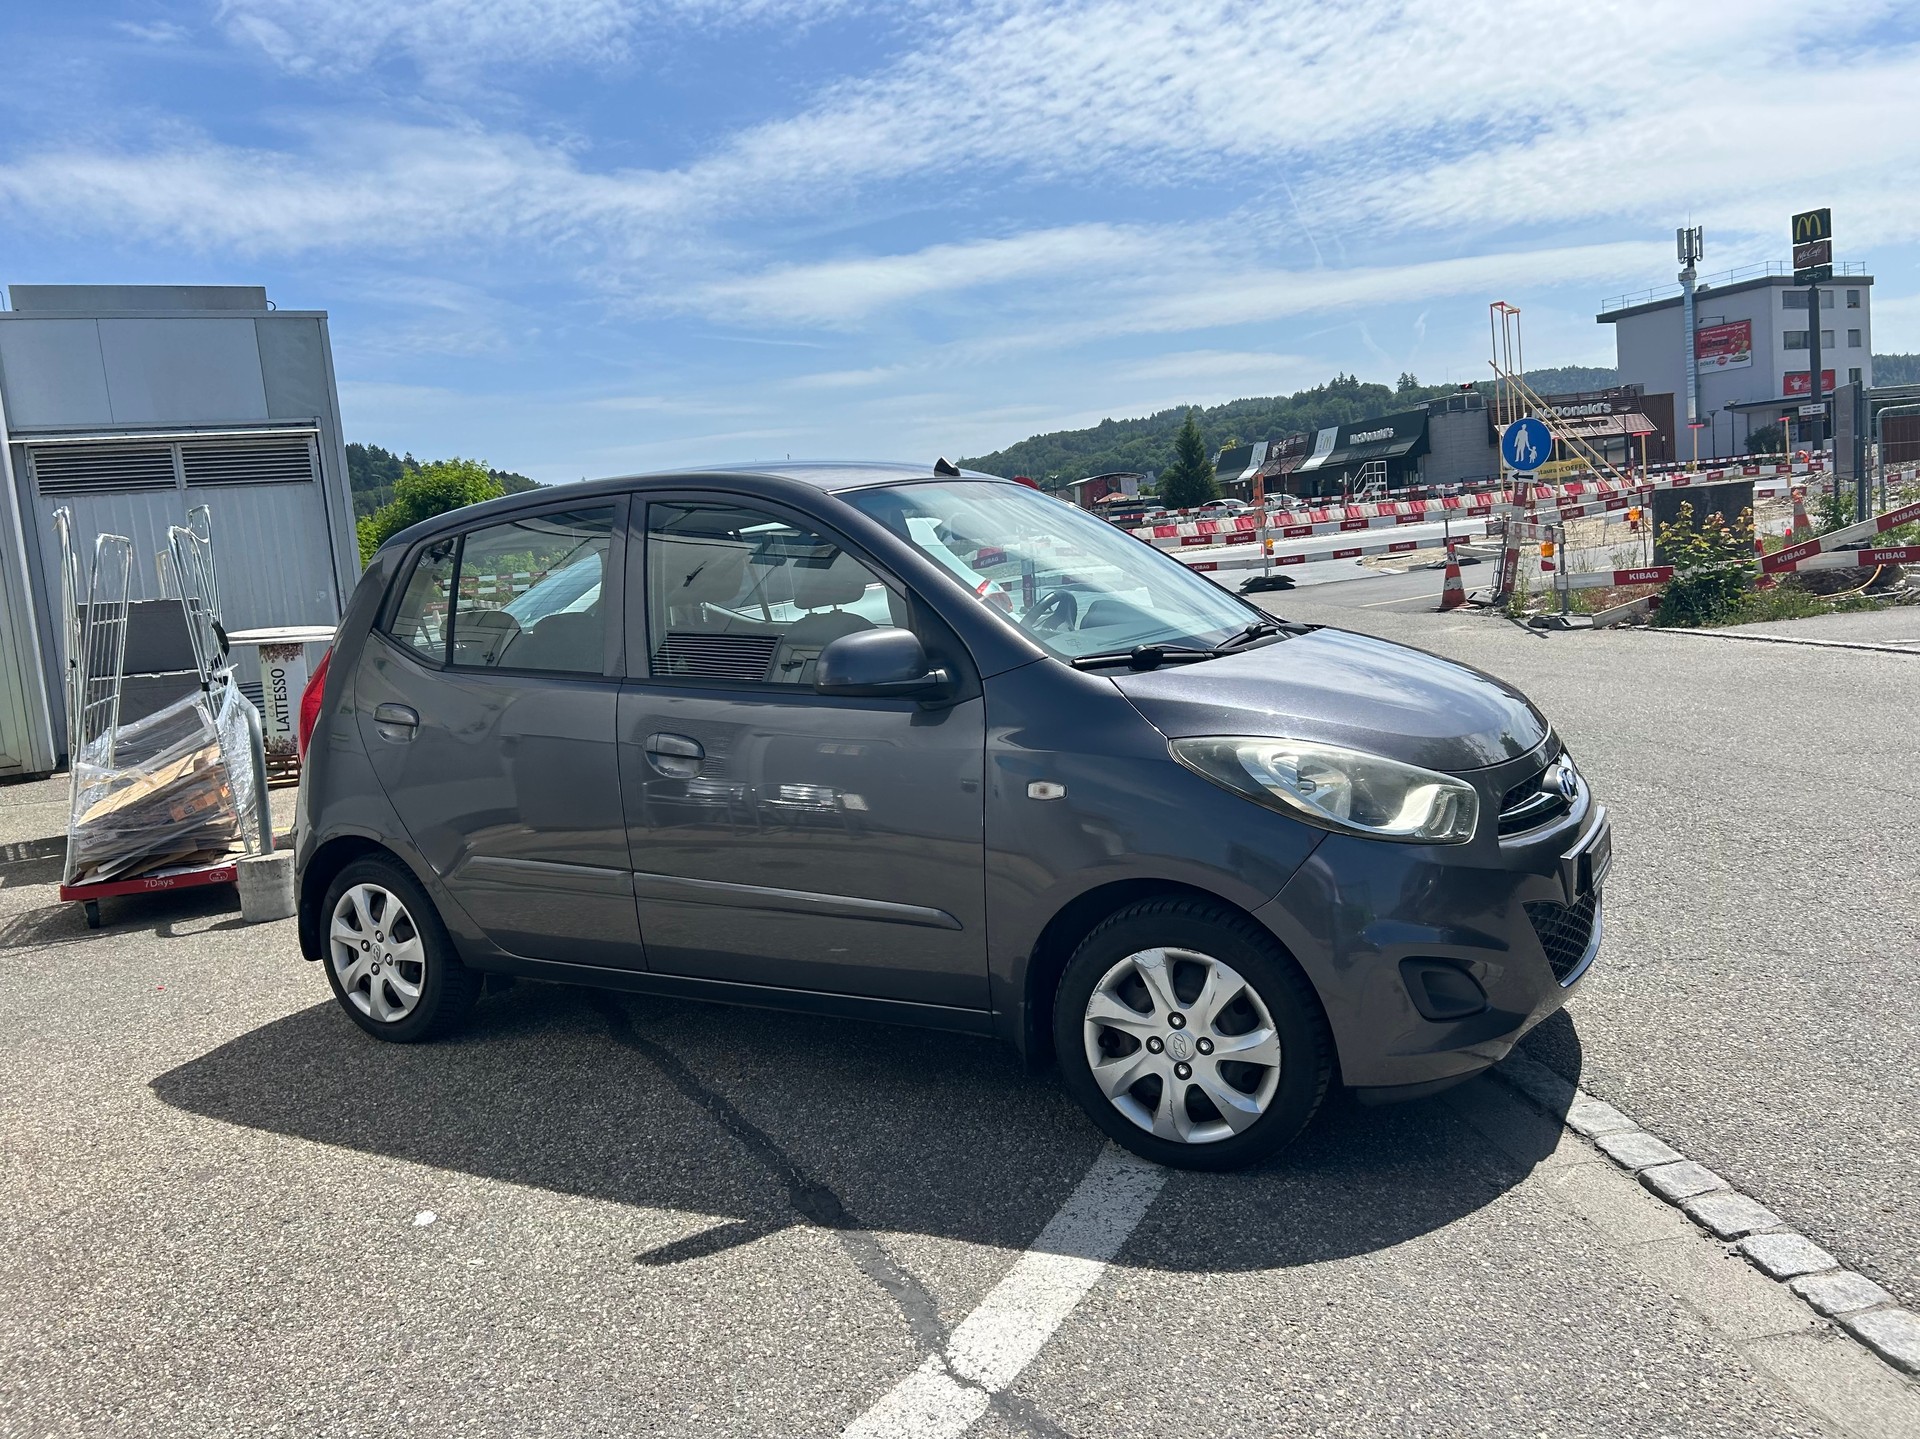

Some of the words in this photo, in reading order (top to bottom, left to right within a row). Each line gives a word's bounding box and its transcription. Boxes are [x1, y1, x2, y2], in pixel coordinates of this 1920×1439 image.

[1531, 402, 1612, 419] McDonald's
[1349, 427, 1394, 445] McDonald's
[1892, 507, 1920, 523] KIBAG
[1777, 548, 1806, 564] KIBAG
[1874, 551, 1906, 560] KIBAG
[1629, 571, 1659, 580] KIBAG
[271, 668, 290, 732] LATTESSO
[144, 879, 175, 888] 7Days
